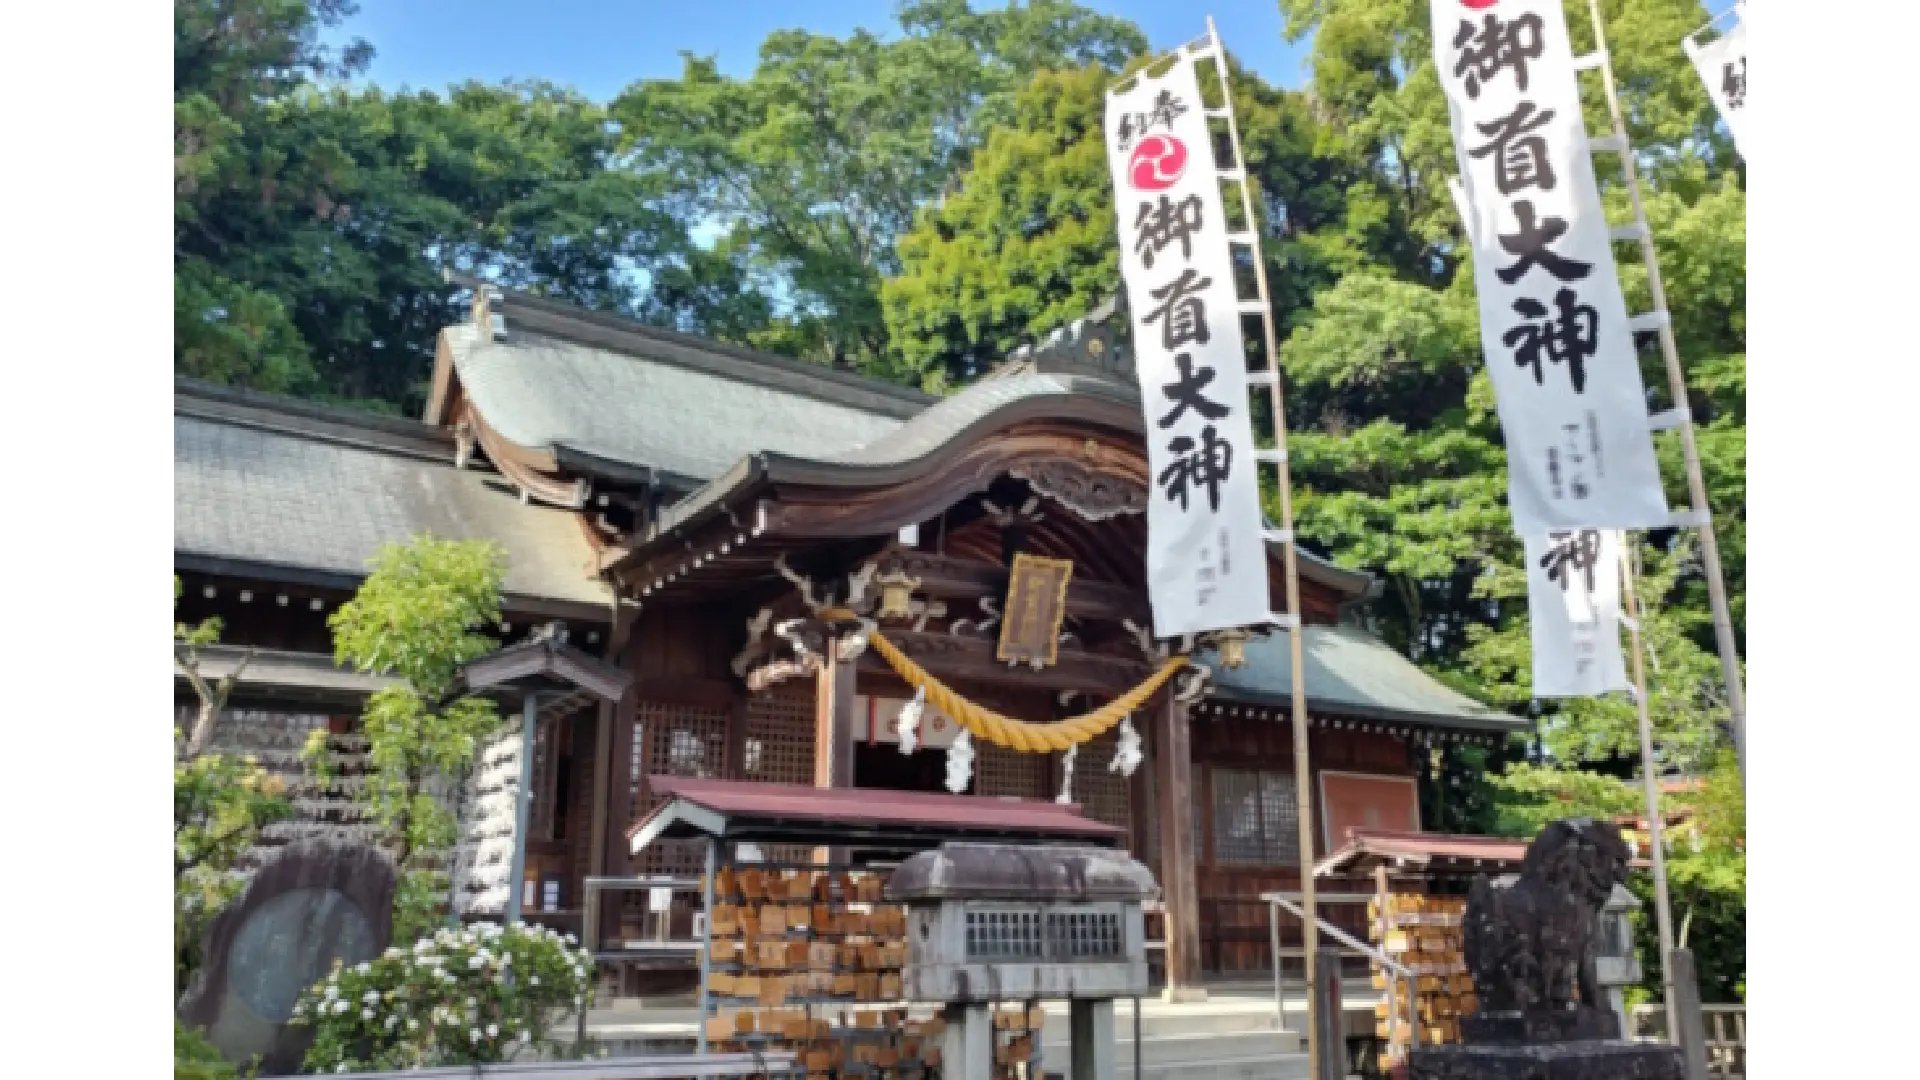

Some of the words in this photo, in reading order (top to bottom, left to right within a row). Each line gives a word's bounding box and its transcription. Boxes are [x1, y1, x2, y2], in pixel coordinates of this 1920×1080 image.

[1134, 194, 1233, 513] 御首大神
[1453, 12, 1599, 394] 御首大神
